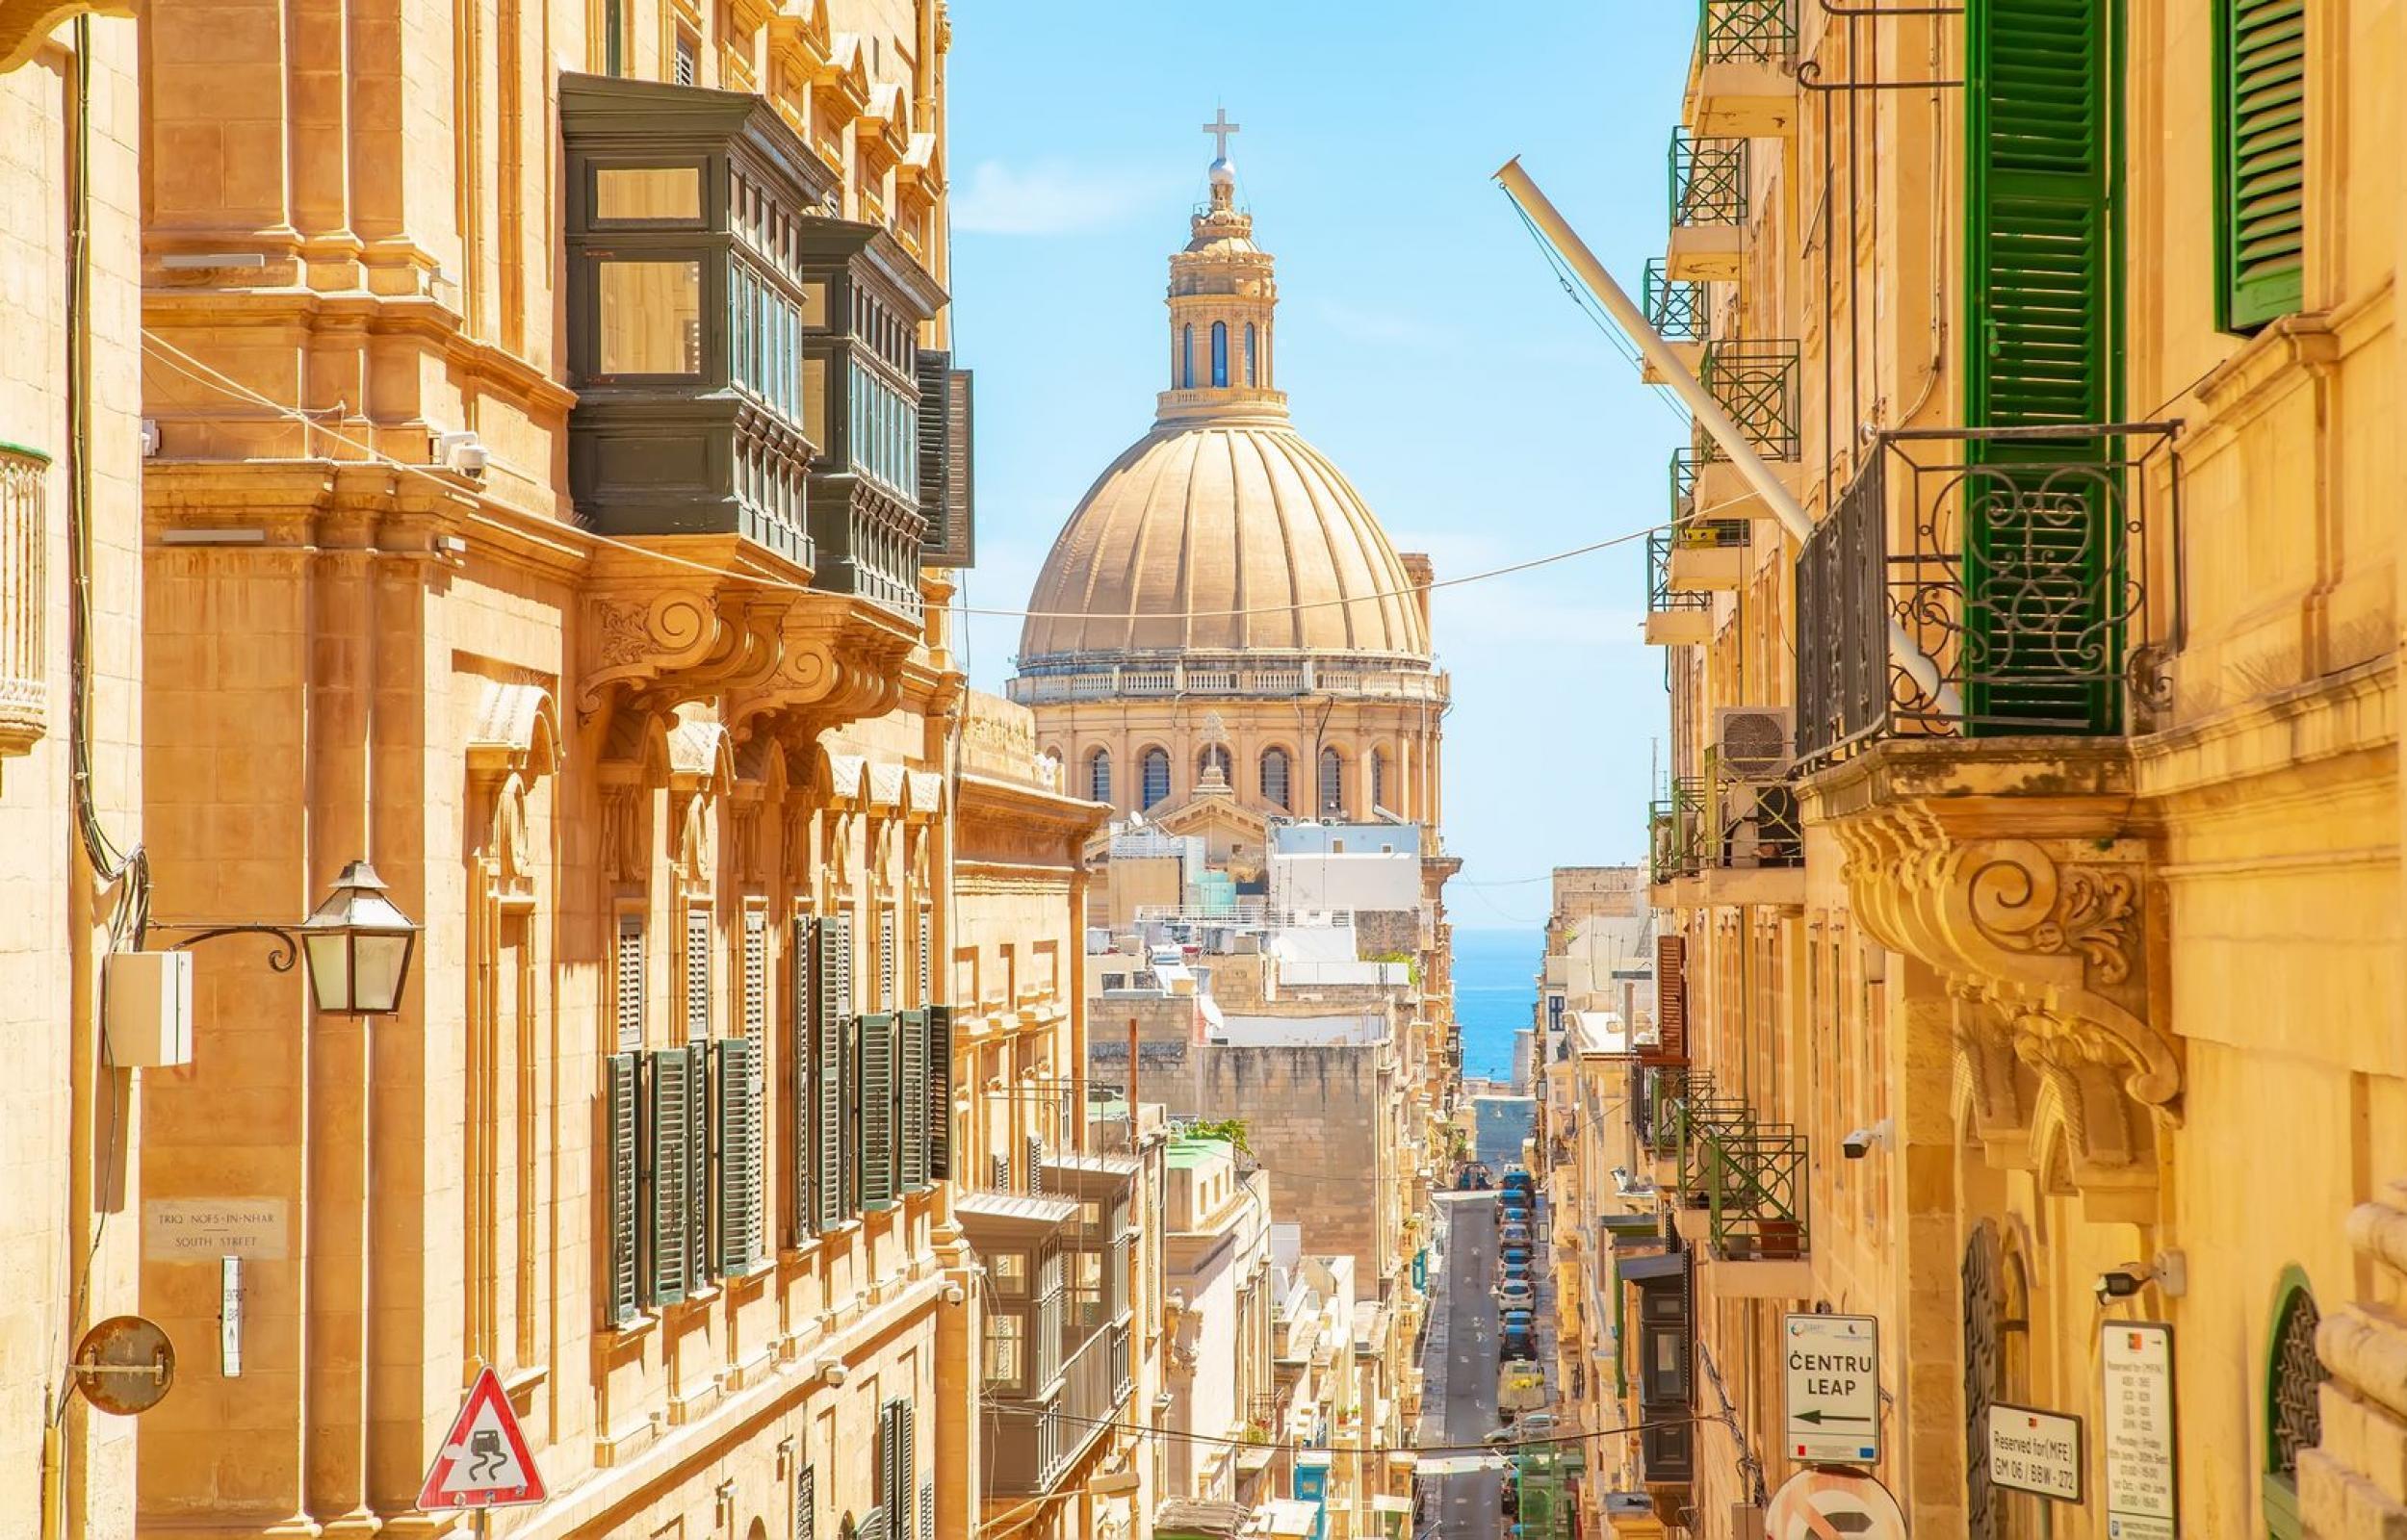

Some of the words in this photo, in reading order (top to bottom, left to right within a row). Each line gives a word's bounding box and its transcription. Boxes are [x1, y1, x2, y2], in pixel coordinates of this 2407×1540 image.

[159, 1214, 183, 1224] TRIQ
[175, 1237, 212, 1247] SOUTH
[220, 1236, 256, 1246] STREET
[1789, 1350, 1872, 1373] ĊENTRU
[1808, 1379, 1856, 1397] LEAP
[1994, 1430, 2032, 1454] Reserved
[1995, 1457, 2009, 1476] GM
[2011, 1460, 2023, 1479] 06
[2058, 1470, 2073, 1490] 272
